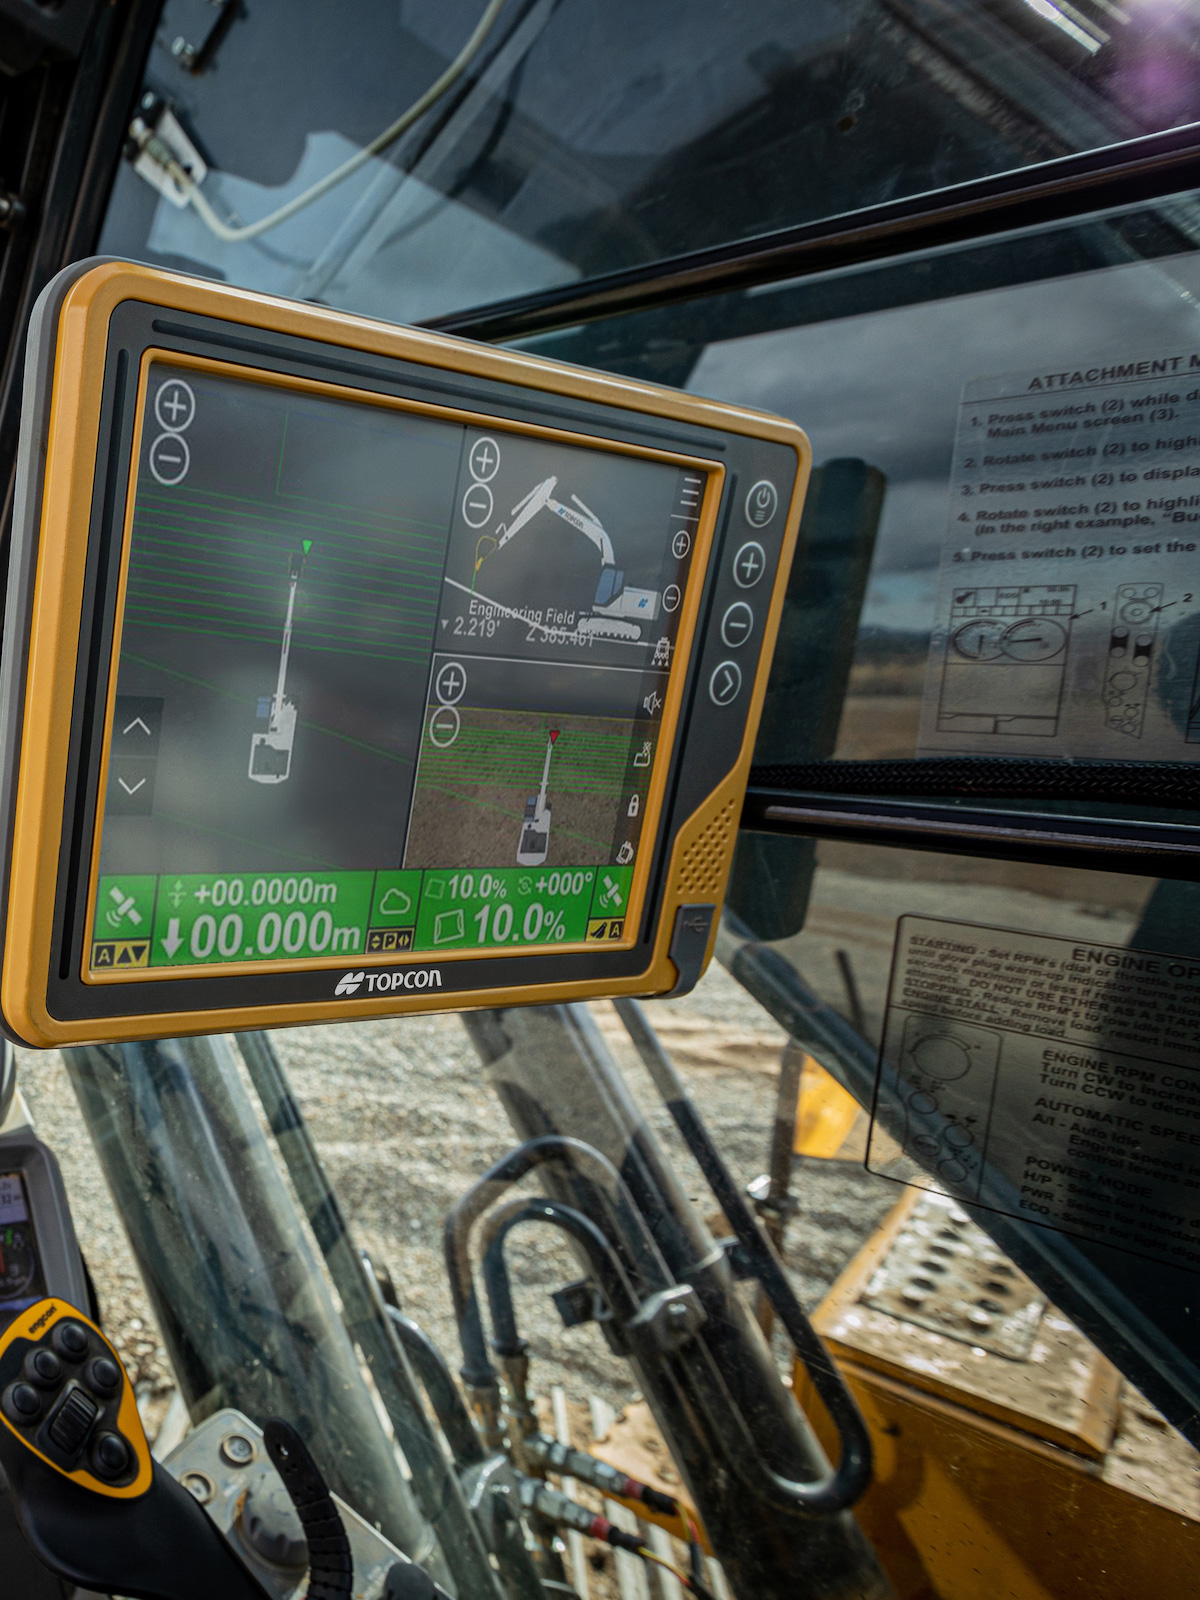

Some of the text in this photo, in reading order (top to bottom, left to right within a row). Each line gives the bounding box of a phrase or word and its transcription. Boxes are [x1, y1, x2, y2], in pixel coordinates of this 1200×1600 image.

[1027, 356, 1184, 391] ATTACHMENT
[970, 389, 1200, 427] 1. Press switch (2) while d
[987, 407, 1180, 439] Main Menu screen (3).
[983, 453, 1036, 467] Rotate
[1040, 446, 1097, 460] switch
[1102, 442, 1126, 457] (2)
[1131, 442, 1150, 452] to
[979, 482, 1025, 494] Press
[1030, 475, 1086, 490] switch
[1091, 472, 1114, 487] (2)
[1120, 472, 1138, 482] to
[1143, 465, 1200, 481] displa
[976, 508, 1029, 520] Rotate
[1033, 503, 1090, 518] switch
[1094, 501, 1118, 516] (2)
[1123, 500, 1142, 511] to
[1146, 494, 1200, 511] highli
[1000, 522, 1026, 533] the
[1031, 518, 1070, 533] right
[1074, 513, 1156, 528] example,
[1162, 511, 1200, 524] “Bu
[971, 550, 1017, 561] Press
[1021, 547, 1076, 560] switch
[1081, 545, 1104, 559] (2)
[1109, 545, 1128, 555] to
[1131, 542, 1161, 555] set
[1166, 541, 1197, 553] the
[468, 599, 576, 625] Engineering Field
[1100, 601, 1107, 611] 1
[1182, 593, 1193, 603] 2
[453, 616, 501, 638] 2.219'
[194, 877, 338, 907] +00.0000m
[448, 871, 593, 899] 10.0% +000°
[190, 910, 360, 958] 00.000m
[474, 902, 566, 943] 10.0%
[610, 924, 620, 934] A
[98, 948, 111, 963] A
[386, 935, 397, 947] P
[1072, 947, 1200, 979] ENGINE OP
[1095, 969, 1110, 977] or
[365, 969, 443, 992] TOPCON
[971, 960, 1001, 971] plug
[1068, 975, 1133, 992] indicator
[1137, 987, 1178, 1000] turns
[903, 978, 971, 997] STOPPING
[1084, 1012, 1099, 1021] to
[1165, 1027, 1188, 1038] for
[969, 979, 990, 989] DO
[993, 983, 1021, 996] NOT
[1025, 988, 1055, 1001] USE
[1060, 995, 1109, 1012] ETHER
[1113, 1007, 1135, 1017] AS
[1139, 1011, 1151, 1020] A
[1030, 981, 1045, 989] or
[1166, 1003, 1200, 1018] Allo
[985, 1015, 1031, 1031] adding
[1011, 1009, 1067, 1026] Remove
[1042, 1049, 1110, 1073] ENGINE
[1114, 1066, 1155, 1083] RPM
[1039, 1073, 1076, 1090] Turn
[1081, 1084, 1125, 1101] CCW
[1129, 1095, 1146, 1106] to
[1040, 1061, 1200, 1107] Turn CW to increa
[1034, 1097, 1200, 1146] AUTOMATIC SPEE
[1070, 1122, 1107, 1139] Auto
[1069, 1134, 1125, 1156] Engine
[1131, 1152, 1184, 1172] speed
[1026, 1155, 1153, 1199] POWER MODE
[1128, 1162, 1179, 1184] levers
[1021, 1185, 1054, 1201] PWR
[1067, 1198, 1110, 1218] Select
[1114, 1212, 1136, 1225] for
[1023, 1170, 1052, 1184] H/P
[1067, 1183, 1113, 1203] Select
[1115, 1198, 1136, 1208] for
[1140, 1204, 1185, 1225] heavy
[1019, 1199, 1050, 1215] ECO
[1062, 1212, 1106, 1233] Select
[1109, 1226, 1130, 1239] for
[28, 1305, 57, 1334] engcon
